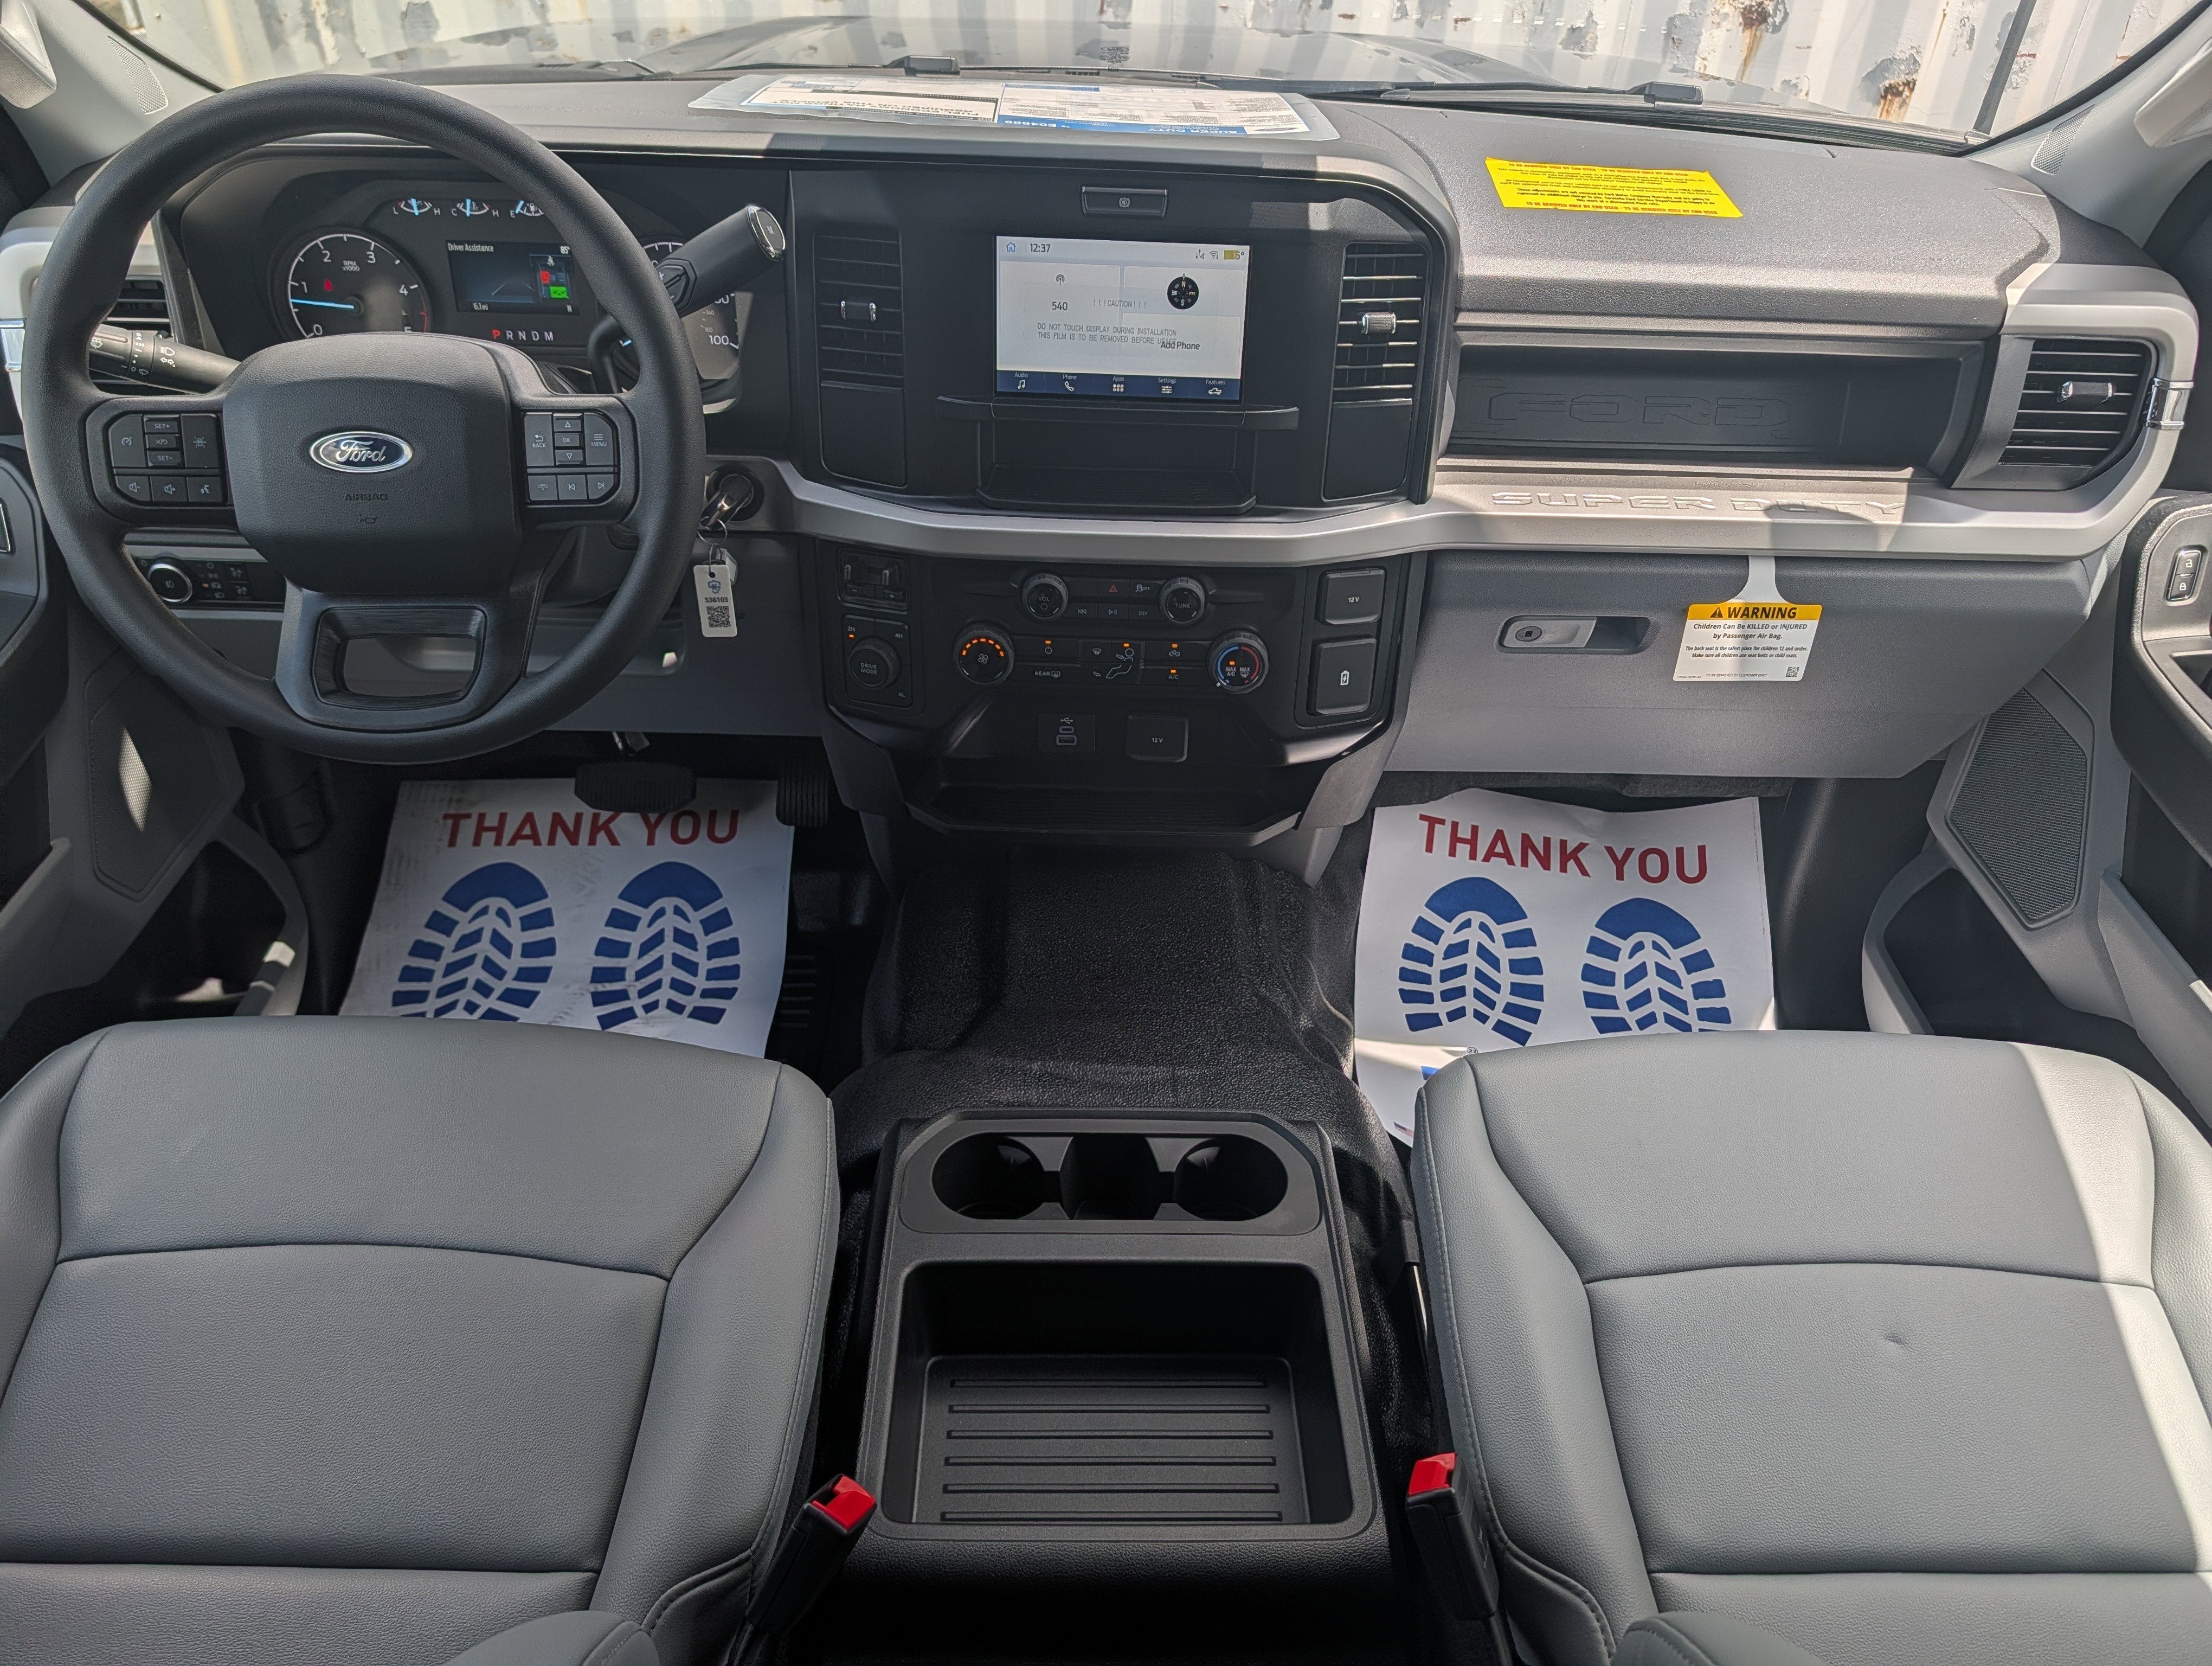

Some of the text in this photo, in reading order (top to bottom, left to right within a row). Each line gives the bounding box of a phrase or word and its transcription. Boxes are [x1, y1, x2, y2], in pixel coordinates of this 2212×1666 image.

[448, 243, 494, 252] Driver Assistance
[1030, 244, 1050, 253] 12:37
[323, 251, 332, 262] 2
[366, 252, 376, 263] 3
[301, 281, 308, 293] 1
[399, 285, 409, 296] 4
[1052, 302, 1068, 310] 540
[313, 324, 323, 335] 0
[491, 329, 554, 341] P R N D M
[1137, 328, 1176, 336] INSTALLATION
[709, 335, 729, 345] 100
[1176, 342, 1200, 350] Phone
[1488, 392, 1791, 426] FORD
[336, 440, 387, 462] Ford
[1492, 492, 1905, 515] SUPER DUTY
[1728, 607, 1797, 619] WARNING
[443, 809, 740, 847] THANK YOU
[1418, 813, 1707, 885] THANK YOU
